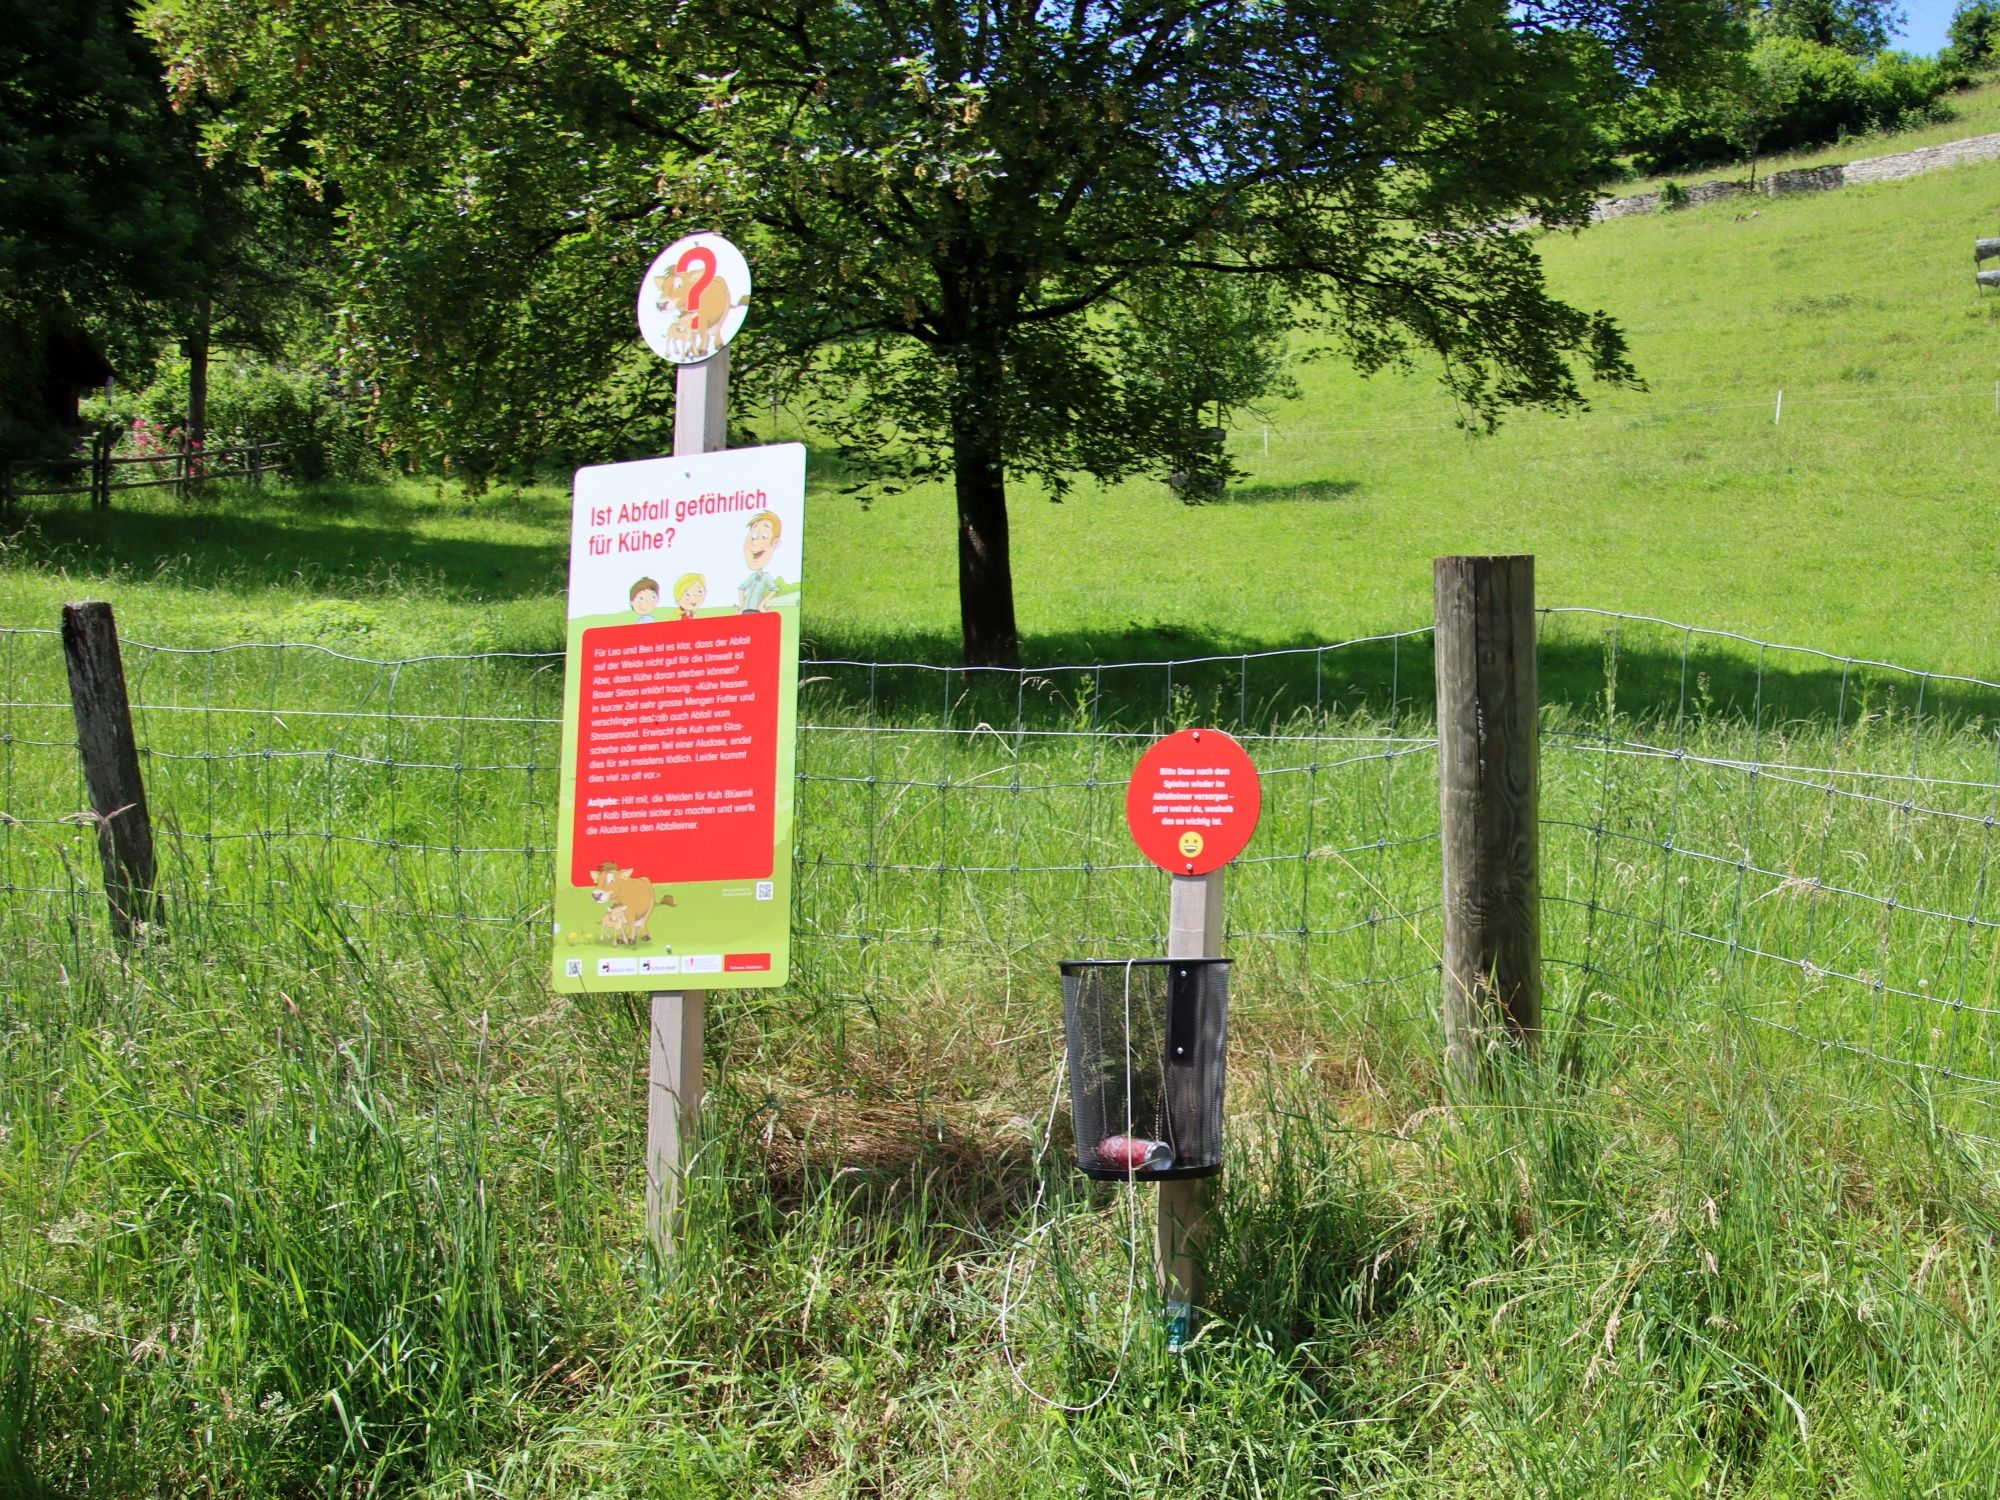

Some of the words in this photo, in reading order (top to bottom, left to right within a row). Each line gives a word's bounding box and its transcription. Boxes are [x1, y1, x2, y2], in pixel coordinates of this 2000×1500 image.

[676, 246, 717, 330] ?
[591, 506, 612, 527] Ist
[618, 500, 669, 524] Abfall
[676, 489, 767, 522] gefährlich
[589, 534, 612, 556] für
[619, 527, 676, 552] Kühe?
[594, 648, 606, 657] Für
[623, 646, 637, 655] und
[639, 645, 653, 653] Ben
[655, 644, 664, 652] ist
[695, 640, 713, 649] dass
[715, 639, 727, 647] der
[730, 636, 751, 646] Abfall
[594, 662, 605, 671] auf
[608, 661, 619, 670] der
[622, 659, 643, 669] Weide
[645, 658, 664, 667] nicht
[665, 656, 677, 667] gut
[679, 655, 689, 664] für
[691, 654, 703, 663] die
[705, 651, 732, 661] Umwelt
[614, 674, 631, 684] dass
[633, 672, 652, 681] Kühe
[654, 671, 675, 680] daran
[677, 669, 705, 678] sterben
[707, 666, 739, 675] können?
[592, 690, 613, 699] Bauer
[615, 687, 639, 697] Simon
[640, 685, 664, 695] erklärt
[720, 679, 748, 688] fressen
[592, 704, 599, 713] in
[601, 702, 623, 712] kurzer
[625, 701, 638, 711] Zeit
[640, 700, 656, 709] sehr
[658, 699, 683, 710] grosse
[685, 696, 714, 707] Mengen
[716, 694, 738, 703] Futter
[740, 693, 755, 702] und
[591, 716, 637, 727] verschlingen
[639, 714, 668, 723] deshalb
[670, 712, 688, 721] auch
[691, 710, 712, 719] Abfall
[714, 710, 730, 718] vom
[643, 727, 674, 737] Erwischt
[675, 726, 687, 735] die
[689, 724, 704, 734] Kuh
[706, 723, 722, 732] eine
[590, 745, 619, 755] scherbe
[621, 744, 637, 753] oder
[639, 743, 659, 752] einen
[661, 741, 673, 750] Teil
[675, 740, 694, 749] einer
[730, 736, 752, 745] endet
[589, 760, 604, 769] dies
[606, 759, 617, 768] für
[619, 758, 629, 767] sie
[631, 756, 664, 766] meistens
[695, 752, 718, 761] Leider
[720, 751, 747, 760] kommt
[589, 774, 604, 783] dies
[606, 773, 619, 782] viel
[621, 773, 630, 781] zu
[632, 772, 642, 780] oft
[1164, 780, 1189, 789] Spielen
[1191, 780, 1214, 788] wieder
[1216, 780, 1225, 788] im
[587, 797, 620, 807] Aufgabe:
[622, 795, 634, 804] Hilf
[651, 793, 664, 803] die
[665, 792, 693, 802] Weiden
[695, 790, 706, 799] für
[707, 789, 722, 799] Kuh
[1194, 794, 1228, 802] versorgen
[587, 812, 601, 821] und
[603, 810, 620, 820] Kalb
[649, 807, 672, 817] sicher
[674, 807, 683, 815] zu
[685, 805, 715, 815] machen
[717, 804, 732, 813] und
[1152, 806, 1168, 814] jetzt
[586, 826, 598, 835] die
[599, 824, 629, 835] Aludose
[631, 823, 638, 832] in
[640, 822, 654, 831] den
[1186, 818, 1210, 827] wichtig
